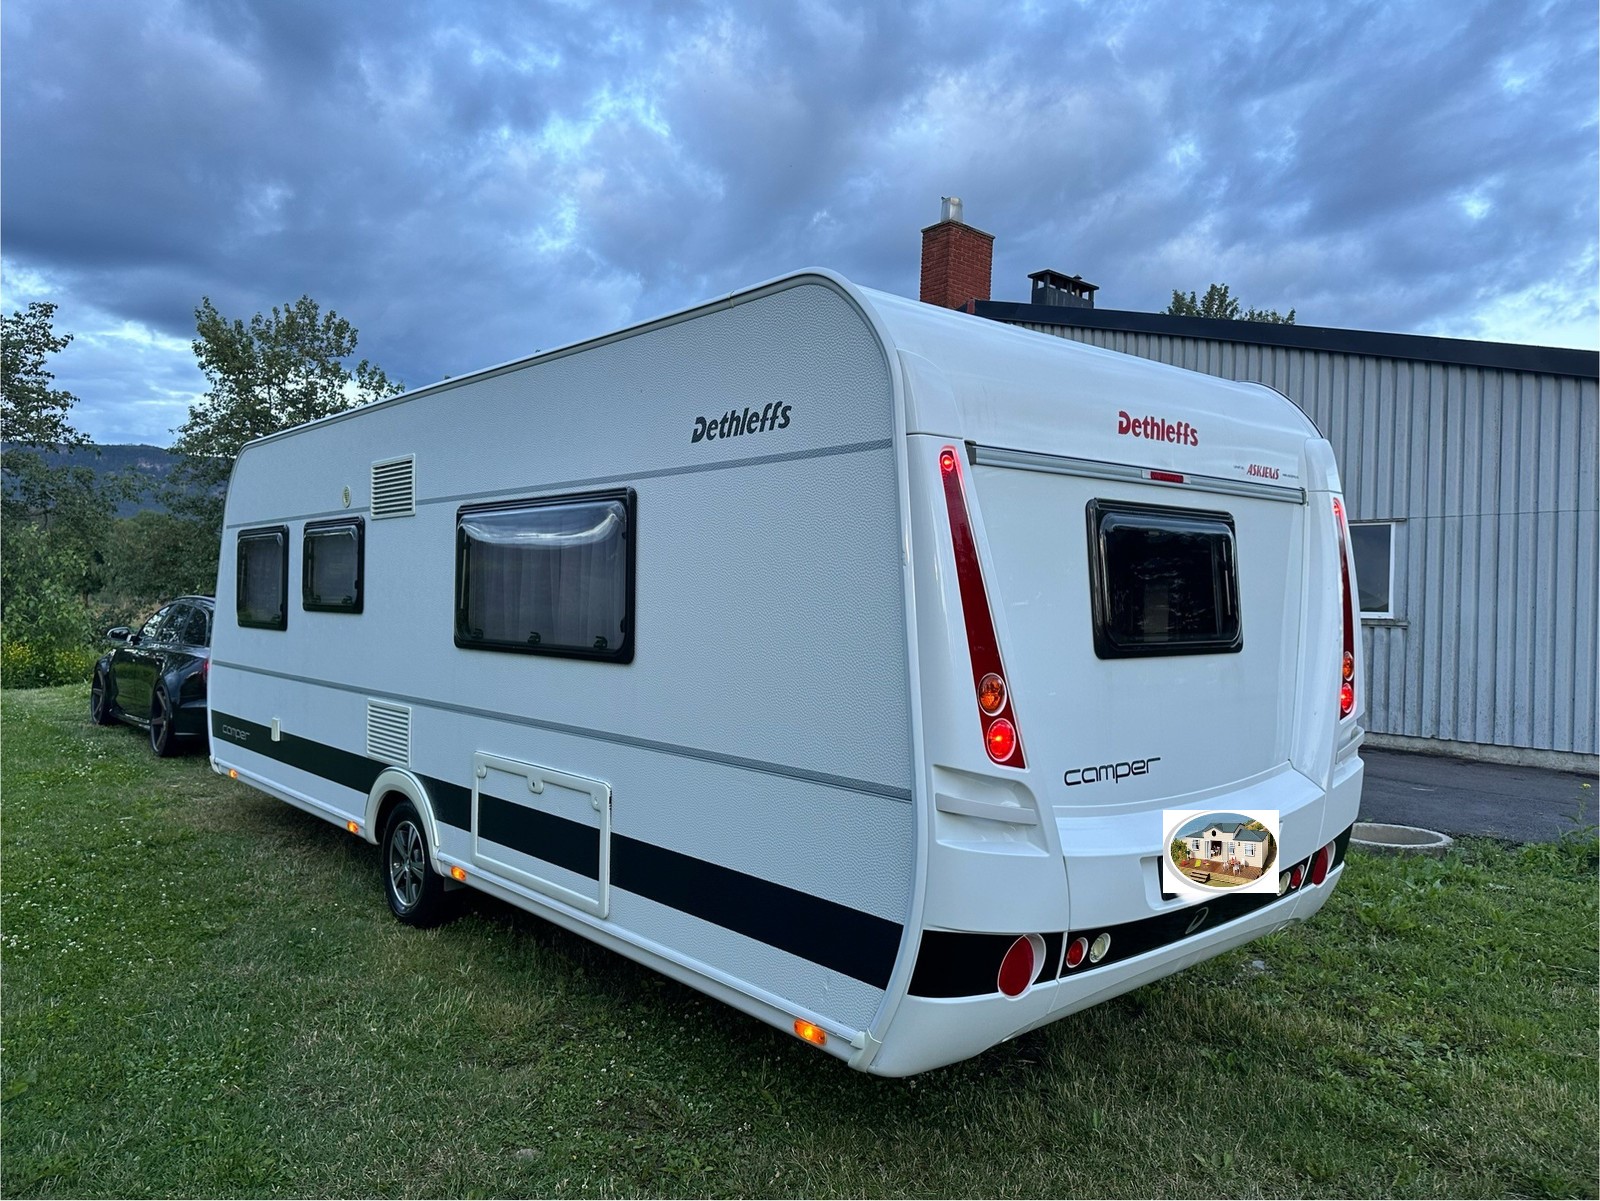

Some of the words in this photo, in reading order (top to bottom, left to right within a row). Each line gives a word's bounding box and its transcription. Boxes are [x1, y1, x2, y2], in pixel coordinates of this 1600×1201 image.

[691, 401, 792, 443] Dethleffs
[1118, 411, 1199, 446] Dethleffs
[222, 724, 250, 740] camper
[1064, 757, 1161, 786] camper
